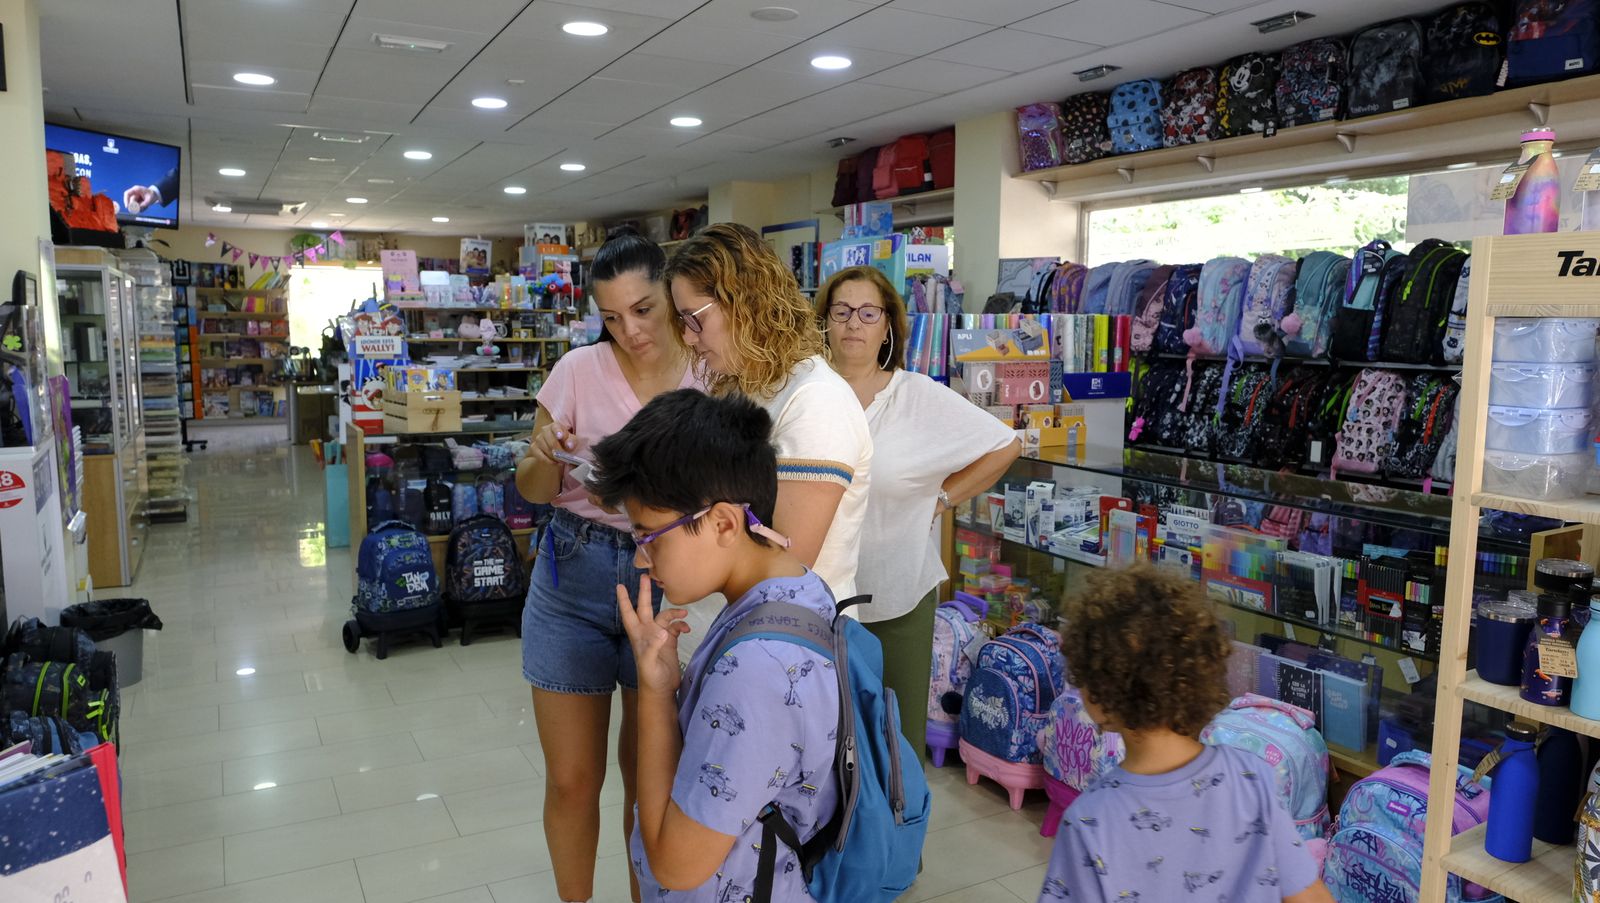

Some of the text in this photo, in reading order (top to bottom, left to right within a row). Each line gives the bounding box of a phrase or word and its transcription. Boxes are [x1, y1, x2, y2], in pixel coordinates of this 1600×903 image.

[906, 253, 931, 262] ILAN
[1557, 251, 1600, 277] Ta
[430, 511, 451, 521] ONLY
[1173, 519, 1199, 529] GIOTTO
[474, 565, 505, 575] GAME
[474, 575, 505, 587] START
